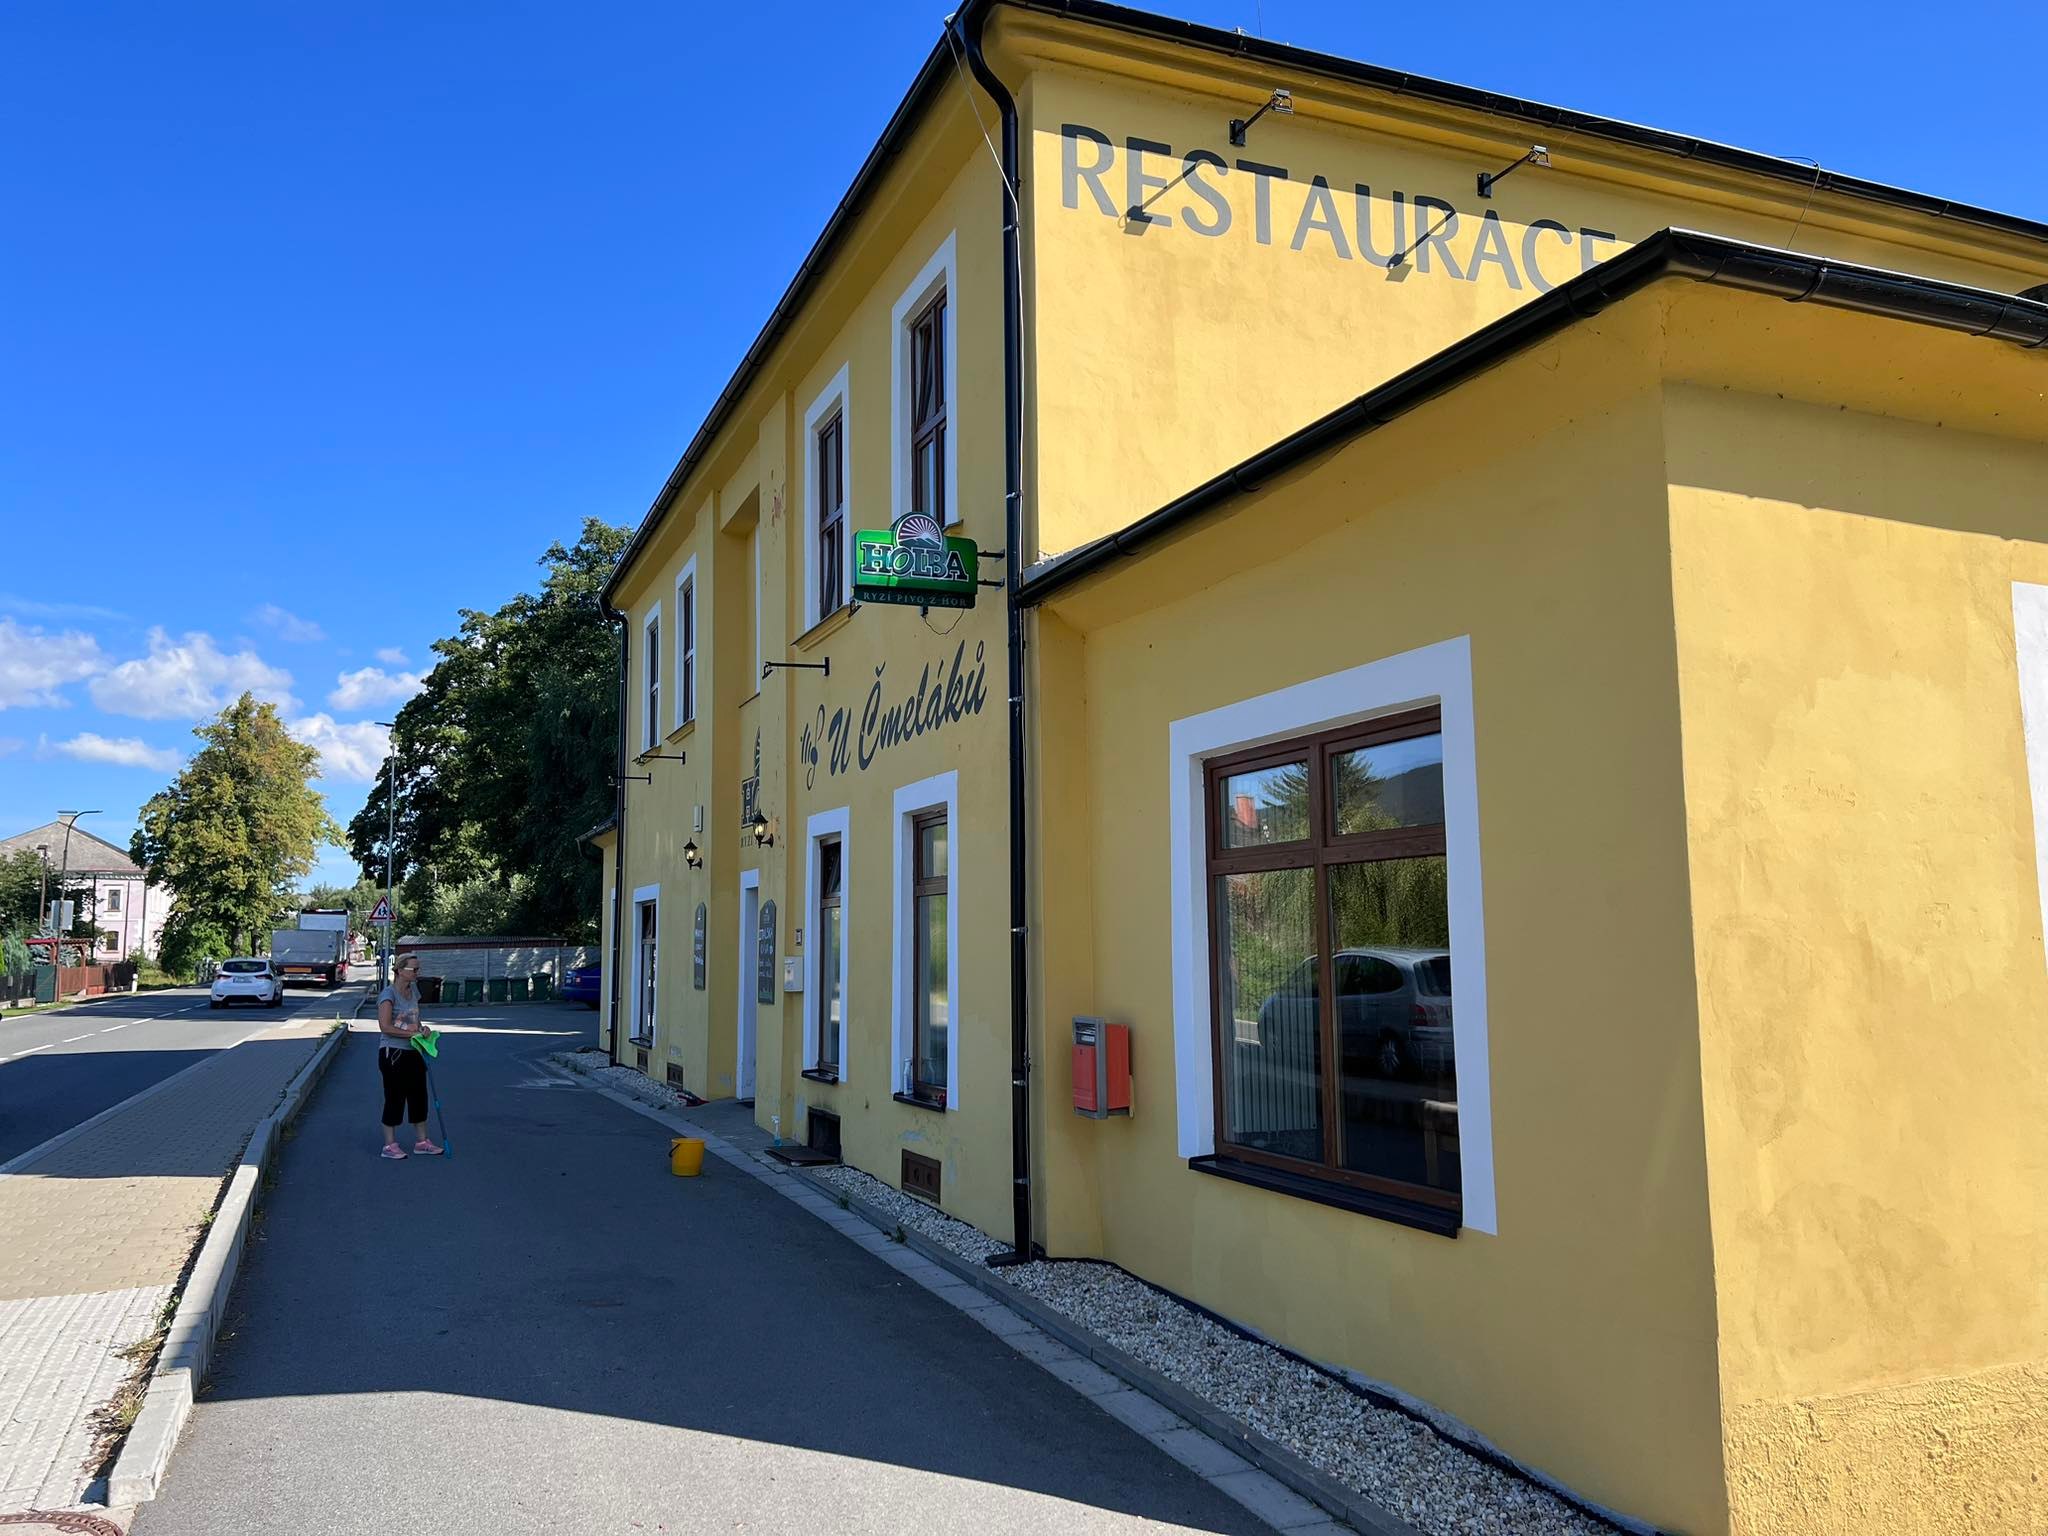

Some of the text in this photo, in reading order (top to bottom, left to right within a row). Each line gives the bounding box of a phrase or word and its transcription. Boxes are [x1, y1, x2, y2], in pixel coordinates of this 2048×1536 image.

[860, 541, 969, 582] HOLBA
[897, 593, 924, 604] PIVO
[929, 596, 937, 604] Z
[942, 597, 967, 607] HOR
[827, 639, 987, 776] U Čmeláků
